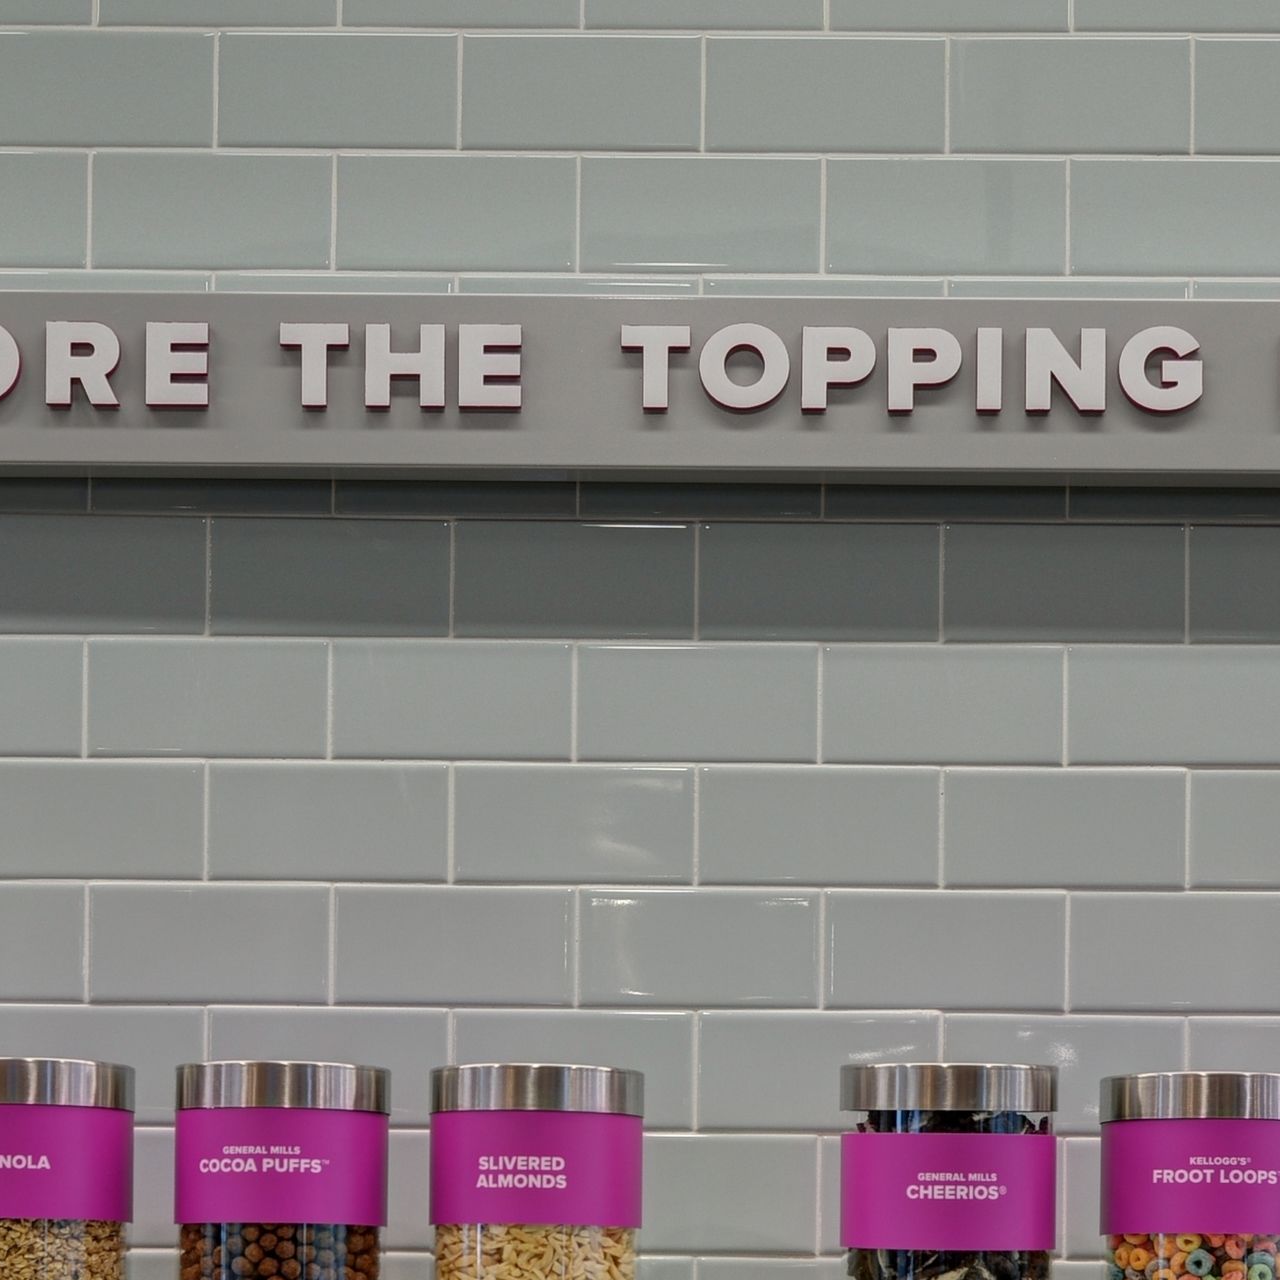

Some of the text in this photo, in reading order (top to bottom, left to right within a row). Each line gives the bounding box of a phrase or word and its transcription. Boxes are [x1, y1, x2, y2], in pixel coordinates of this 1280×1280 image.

[277, 319, 524, 411] THE
[619, 322, 1205, 415] TOPPING
[222, 1145, 302, 1156] GENERAL MILLS
[199, 1157, 258, 1174] COCOA
[478, 1155, 566, 1171] SLIVERED
[475, 1173, 568, 1189] ALMONDS
[916, 1172, 998, 1182] GENERAL MILLS
[1152, 1168, 1215, 1184] FROOT
